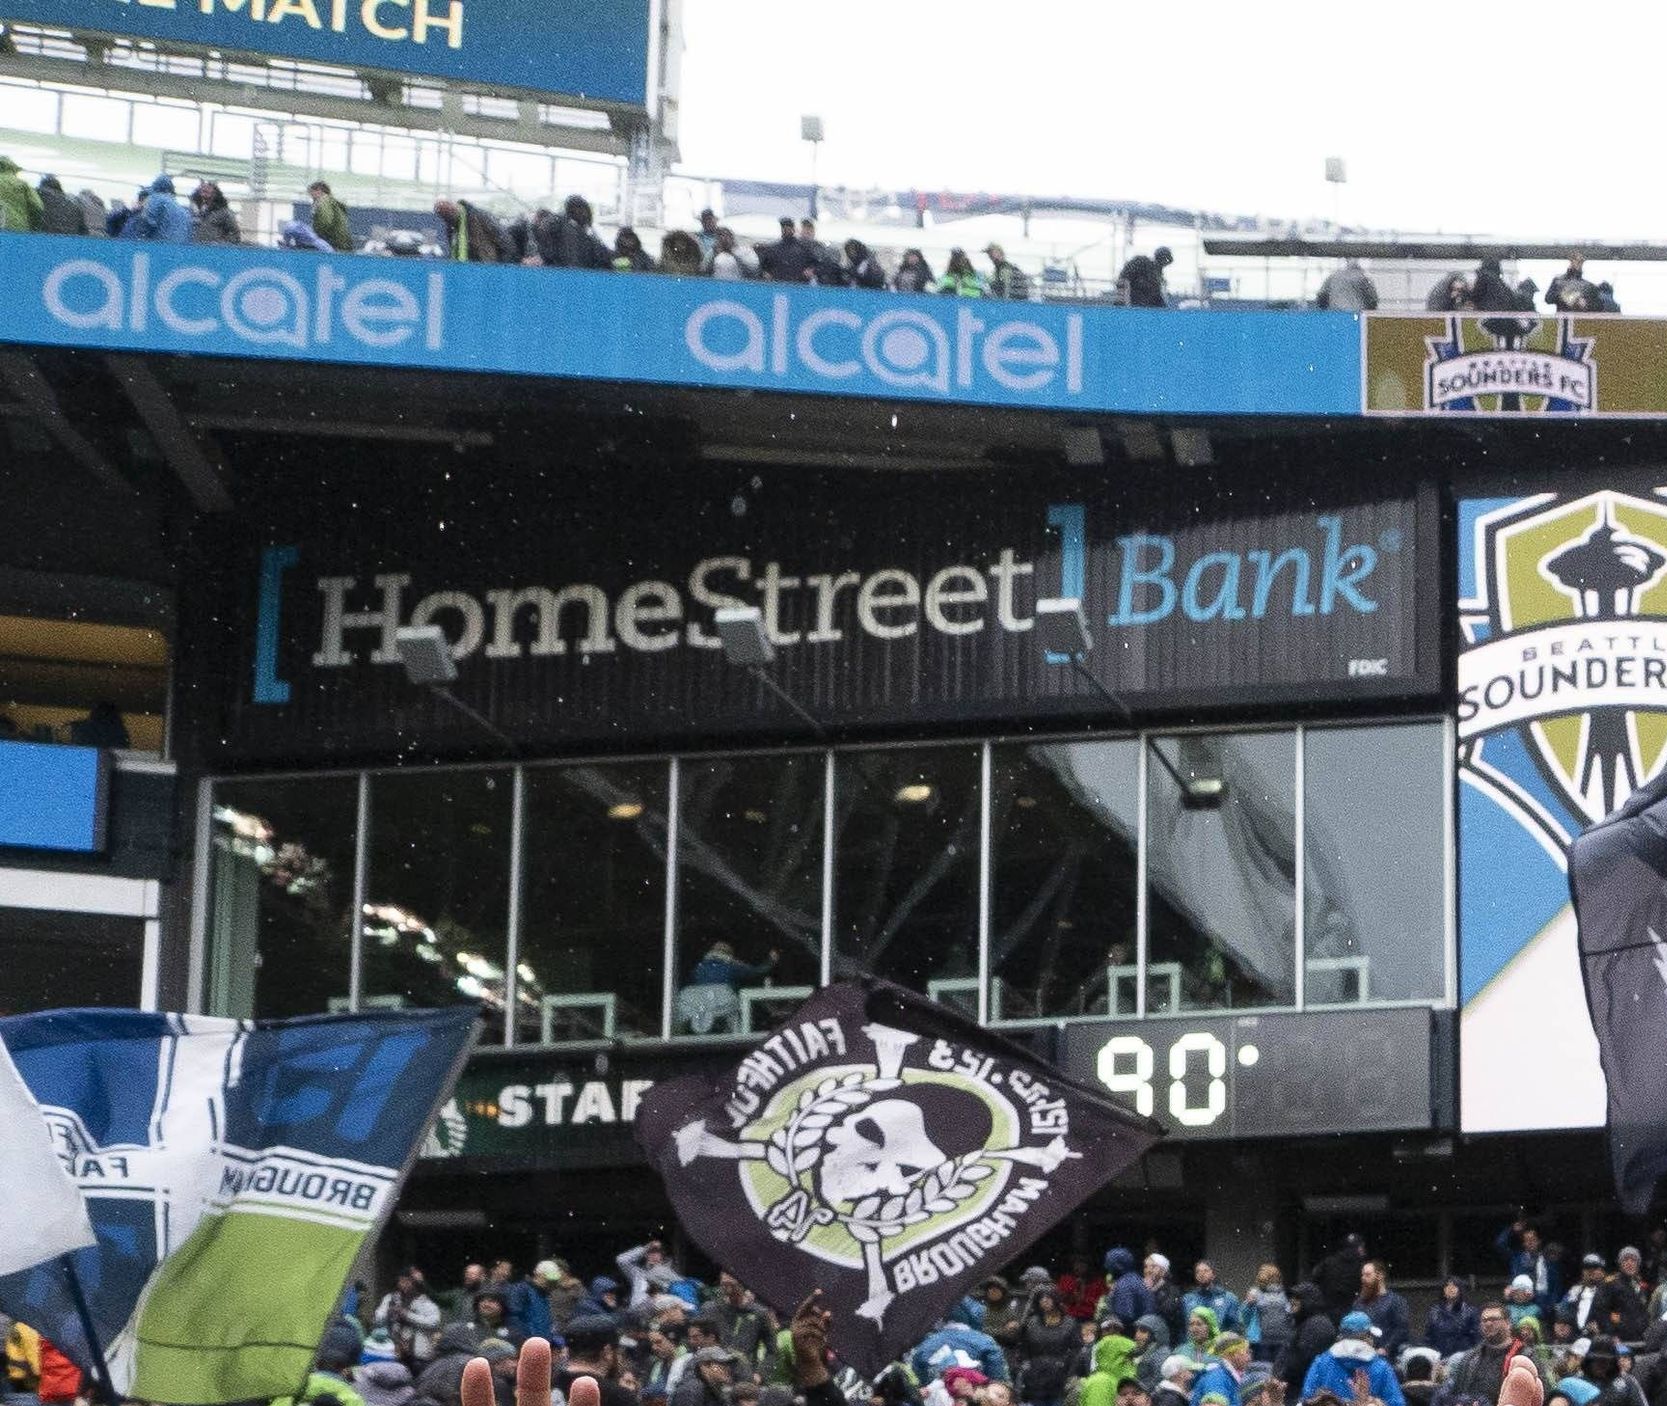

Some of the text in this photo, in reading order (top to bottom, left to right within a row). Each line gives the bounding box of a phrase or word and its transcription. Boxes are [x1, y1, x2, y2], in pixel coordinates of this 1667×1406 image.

[42, 252, 444, 351] alcatel
[684, 295, 1084, 393] alcatel
[1437, 363, 1585, 396] SOUNDERS FC
[312, 514, 1379, 669] HomeStreet Bank
[1347, 657, 1388, 678] FDIC
[1097, 1032, 1226, 1128] 90
